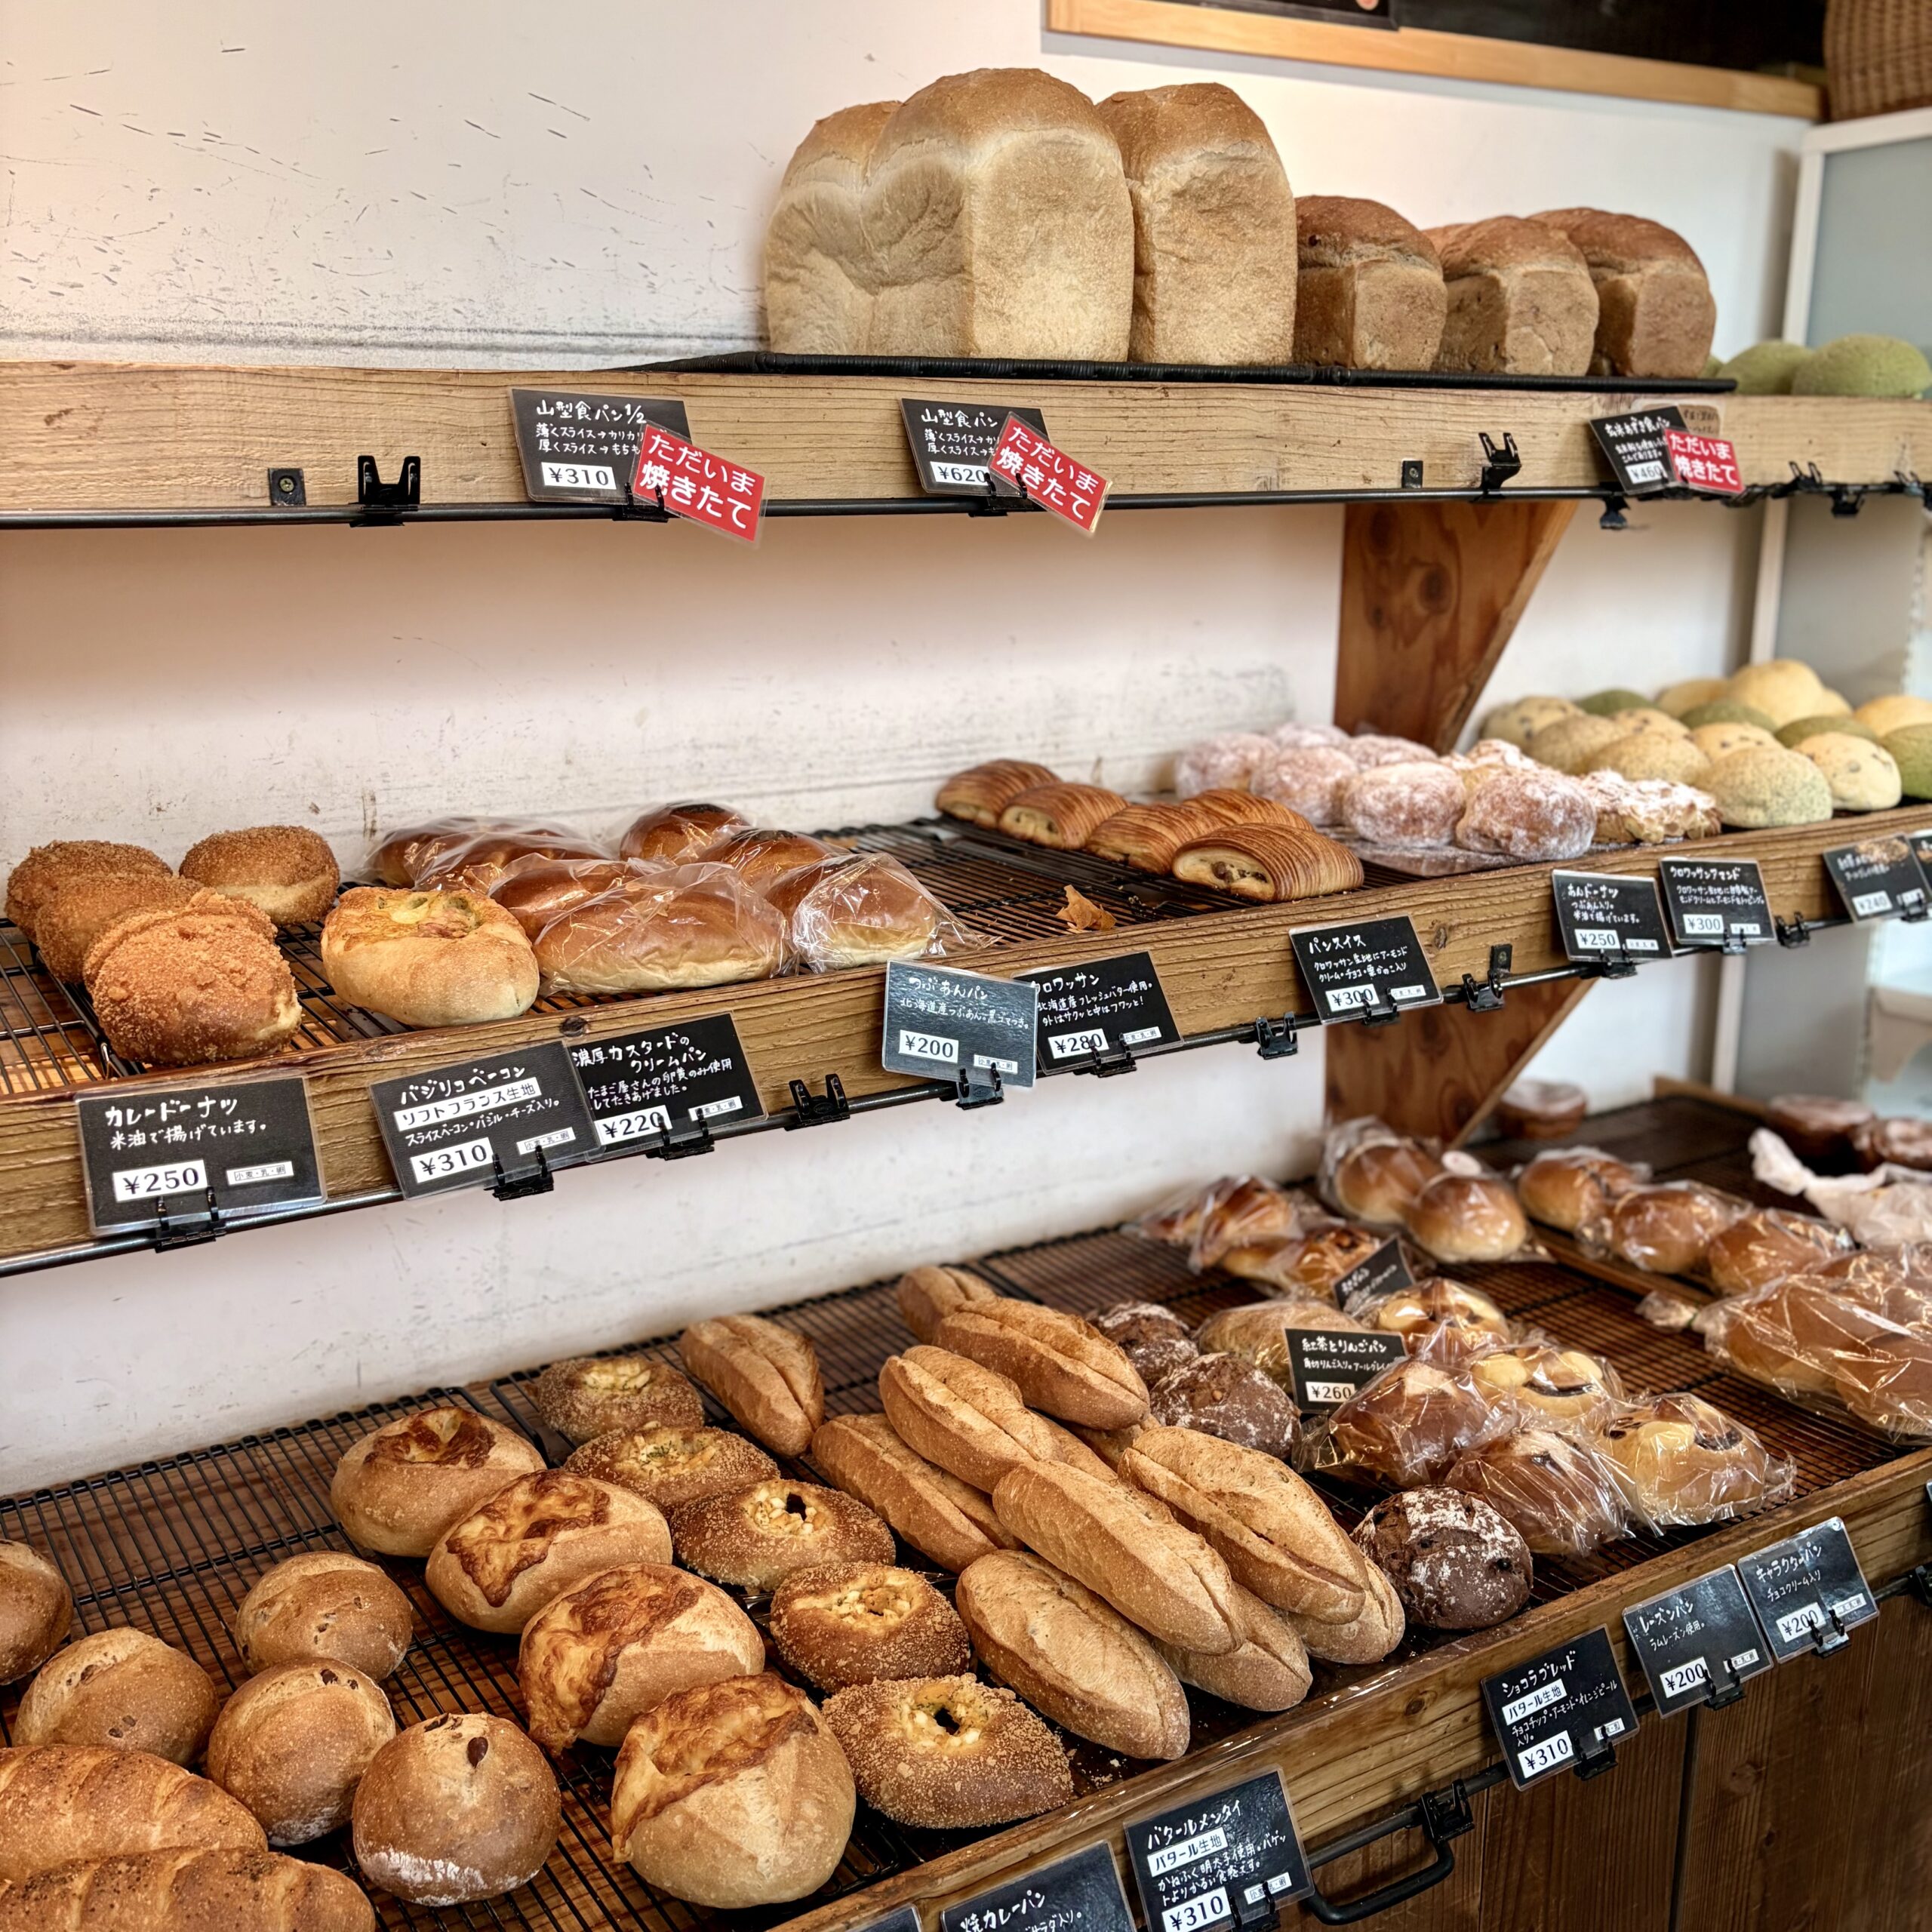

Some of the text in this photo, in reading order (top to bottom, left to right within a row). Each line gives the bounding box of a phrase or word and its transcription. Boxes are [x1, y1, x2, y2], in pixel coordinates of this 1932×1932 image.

[537, 399, 647, 424] 山型食パン1/2
[921, 408, 998, 429] 山型食パン
[1008, 426, 1099, 494] ただいま
[1669, 433, 1731, 460] ただいま
[549, 467, 609, 486] ¥310
[648, 435, 755, 496] ただいま
[937, 466, 986, 483] ¥620
[1630, 463, 1660, 481] ¥460
[1674, 454, 1738, 485] 焼きたて
[640, 460, 752, 529] 焼きたて
[996, 446, 1091, 520] 焼きたて
[1670, 866, 1741, 881] クロワッサンアマンド
[1567, 883, 1619, 899] あんドーナツ
[1687, 918, 1721, 931] ¥300
[1309, 934, 1366, 954] パンスイス
[1580, 933, 1616, 946] ¥250
[1315, 946, 1407, 972] クロワッサン生地にアーモンド
[909, 977, 988, 1000] つぶあんパン
[1031, 972, 1100, 994] クロワッサン
[1037, 980, 1152, 1011] 北海道産フレッシュバター使用。
[1331, 988, 1374, 1007] ¥300
[572, 1032, 690, 1068] 濃厚カスタードの
[905, 1035, 953, 1058] ¥200
[1054, 1033, 1103, 1054] ¥280
[631, 1047, 706, 1073] クリームパン
[588, 1058, 733, 1100] たまご屋さんの卵黄のみ使用
[105, 1095, 238, 1128] カレードーナツ
[403, 1082, 537, 1126] ソフトフランス生地
[110, 1118, 267, 1150] 米油で揚げています。
[602, 1111, 664, 1138] ¥220
[419, 1144, 488, 1176] ¥310
[122, 1168, 199, 1195] ¥250
[1302, 1336, 1387, 1353] 紅茶とりんごパン
[1312, 1386, 1352, 1400] ¥260
[1756, 1541, 1822, 1583] キャラクターパン
[1767, 1568, 1821, 1602] チョコクリーム入り
[1639, 1598, 1694, 1634] レーズンパン
[1782, 1609, 1819, 1636] ¥200
[1650, 1620, 1706, 1651] ラムレーズン使用。
[1502, 1651, 1576, 1698] ショコラブレッド
[1665, 1663, 1705, 1691] ¥200
[1509, 1685, 1562, 1720] バタール生地
[1512, 1679, 1617, 1737] チョコチップ・アーモンド・オレンジピール
[1517, 1735, 1534, 1747] 入り。
[1524, 1738, 1569, 1770] ¥310
[1148, 1799, 1241, 1850] バタールメンタイ
[1155, 1834, 1223, 1871] バタール生地
[960, 1890, 1045, 1932] 焼カレーパン
[1169, 1895, 1224, 1932] ¥310
